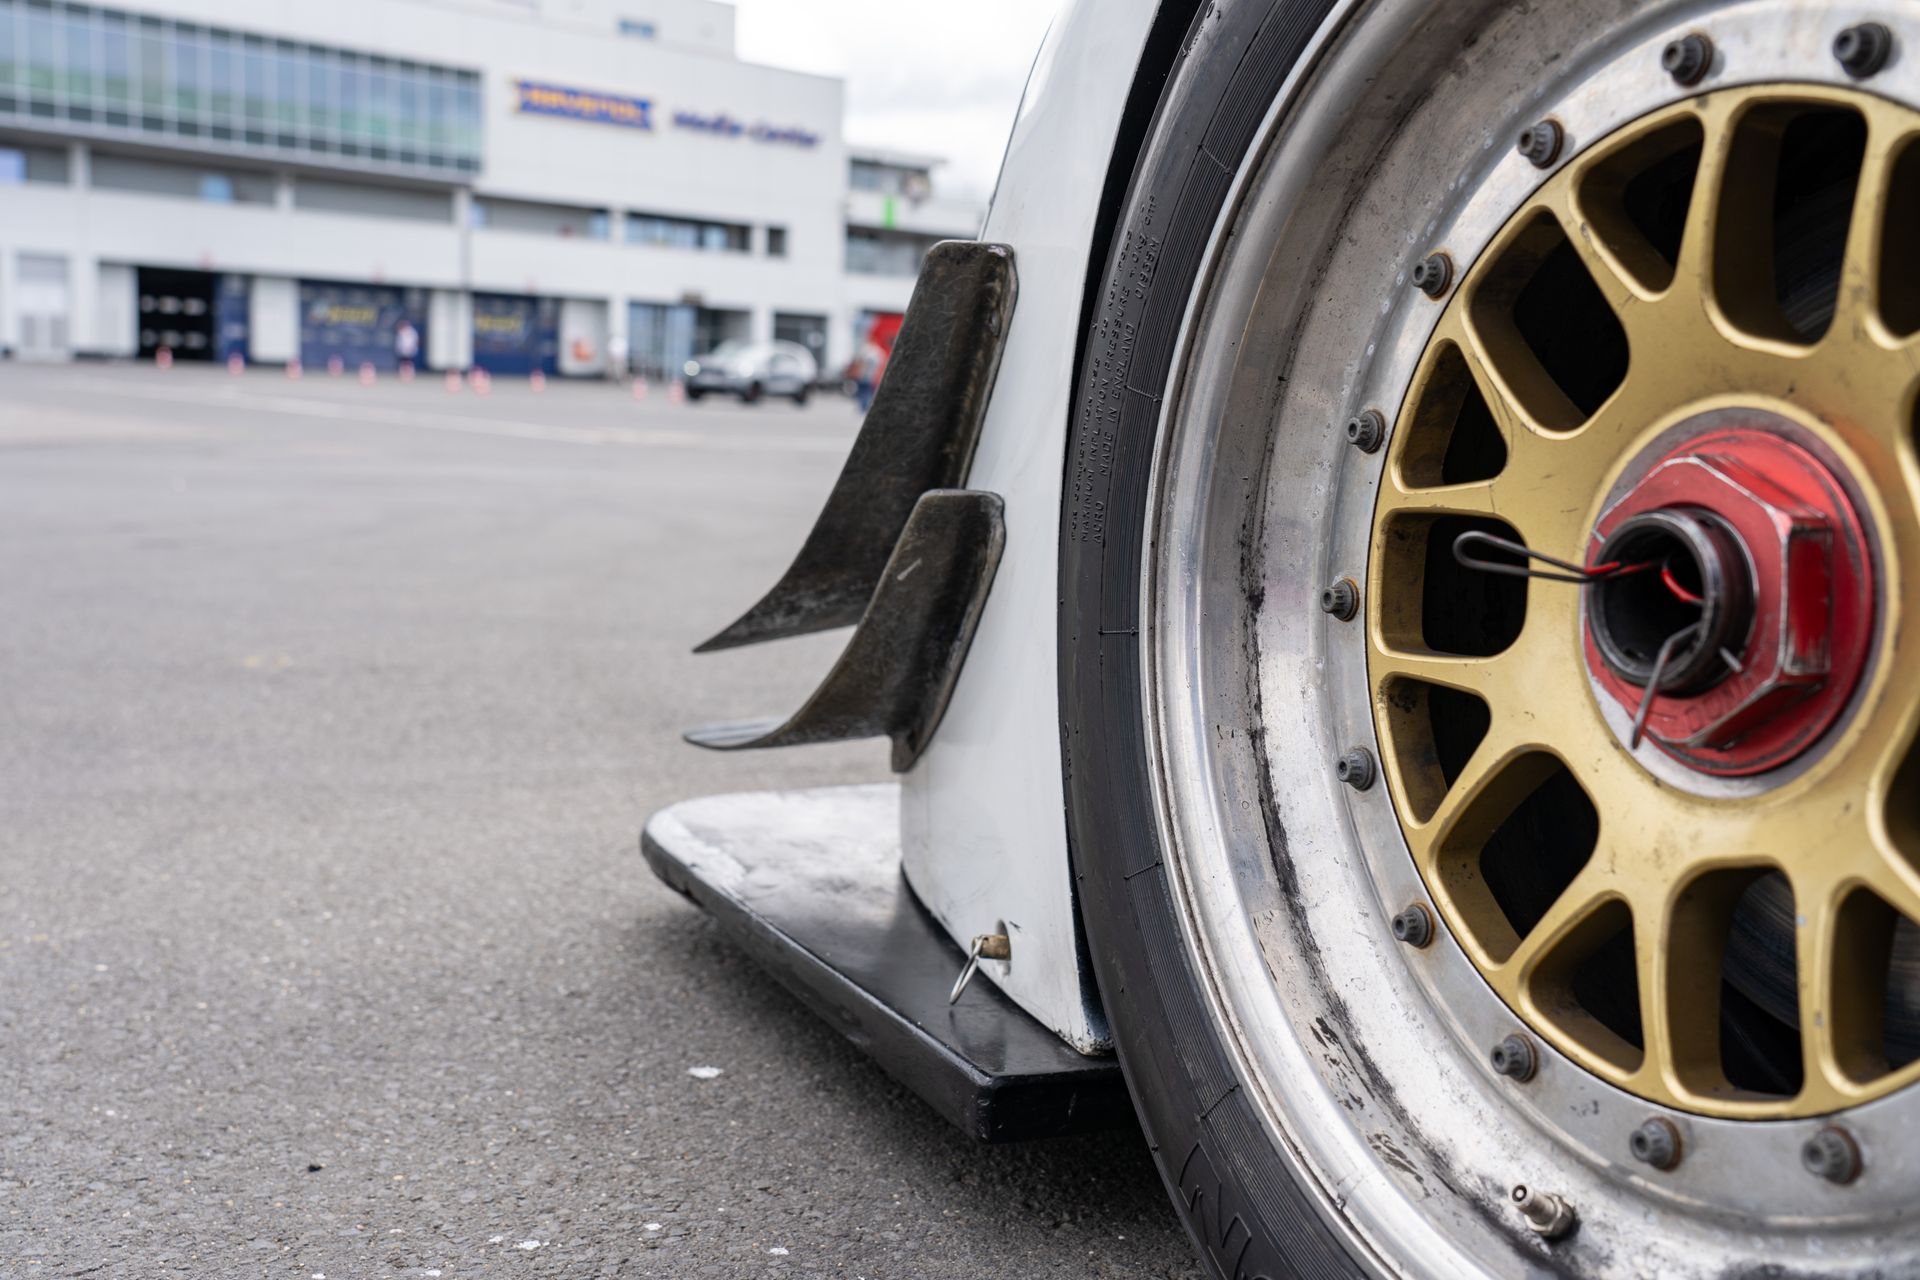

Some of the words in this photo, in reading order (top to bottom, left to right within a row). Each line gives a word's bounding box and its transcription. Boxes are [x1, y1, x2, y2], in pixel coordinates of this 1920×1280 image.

[1110, 321, 1135, 400] ENGLAND
[1079, 469, 1095, 543] MAXIMUM
[1087, 377, 1109, 462] INFLATION
[1103, 286, 1130, 372] PRESSURE
[1105, 406, 1118, 424] IN
[1099, 431, 1114, 477] MADE
